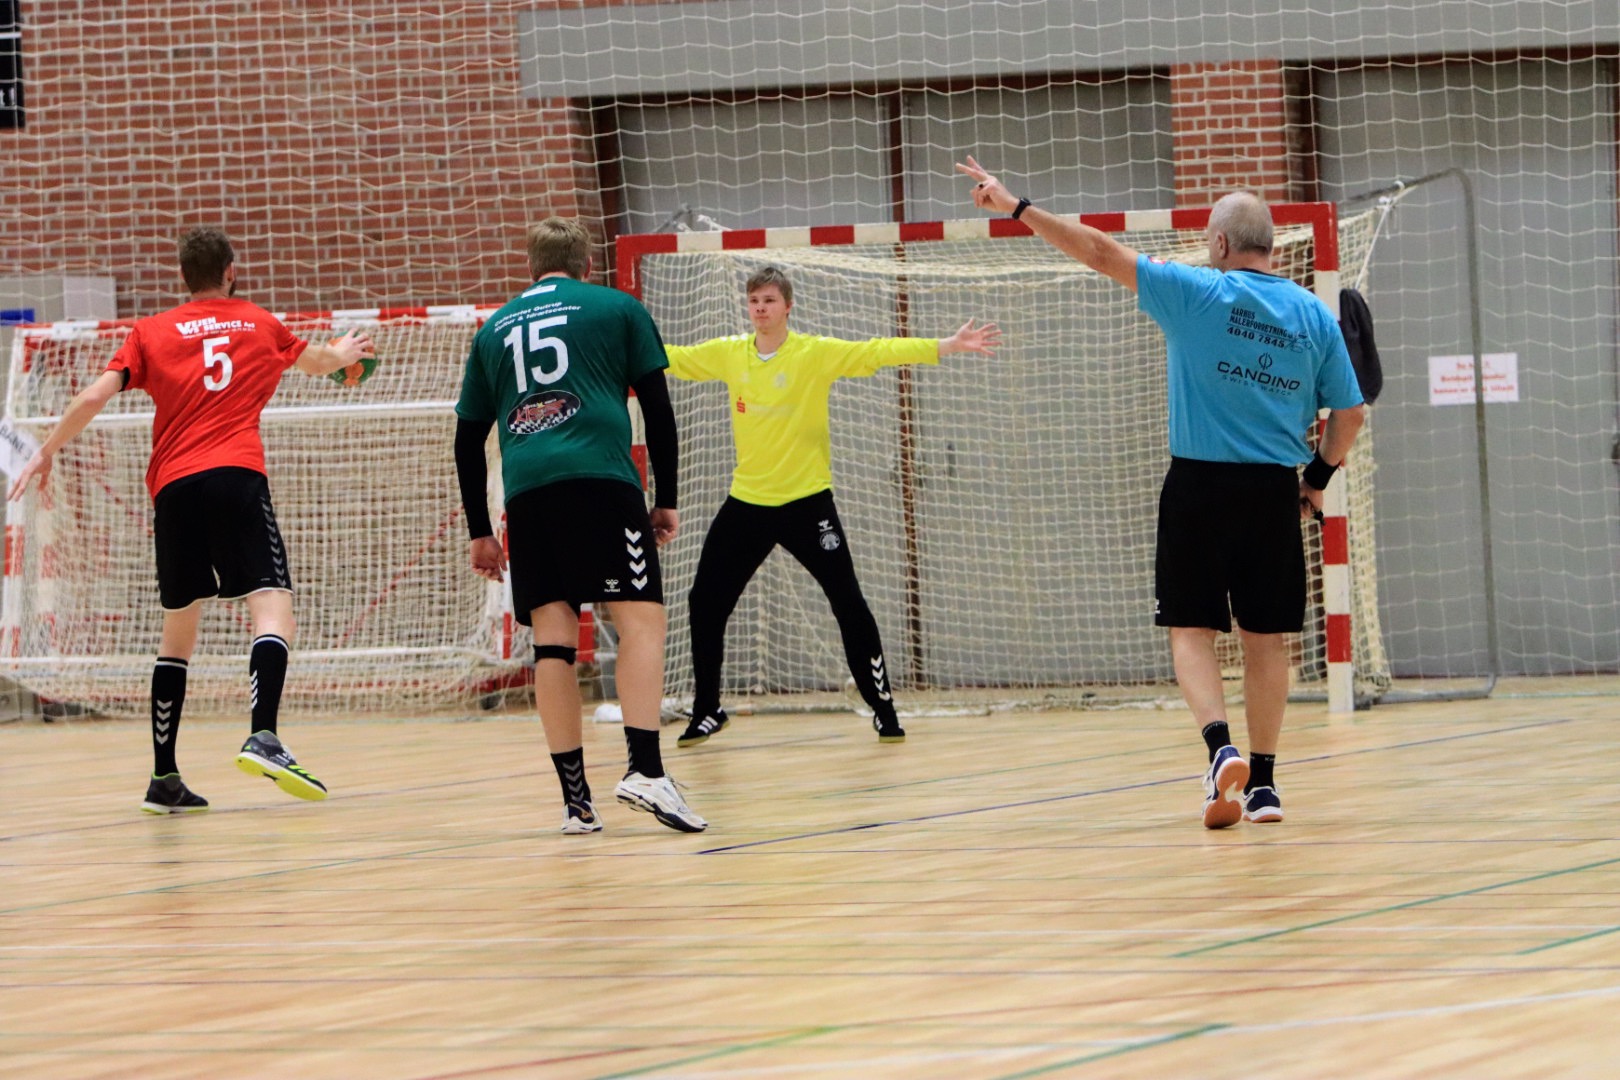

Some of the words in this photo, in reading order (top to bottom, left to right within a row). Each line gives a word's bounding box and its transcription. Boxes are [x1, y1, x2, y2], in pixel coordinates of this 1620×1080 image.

[203, 320, 242, 331] SERVICE
[1227, 326, 1255, 340] 4040
[1258, 334, 1285, 348] 7845
[202, 335, 233, 391] 5
[503, 315, 569, 394] 15
[1217, 361, 1301, 390] CANDINO
